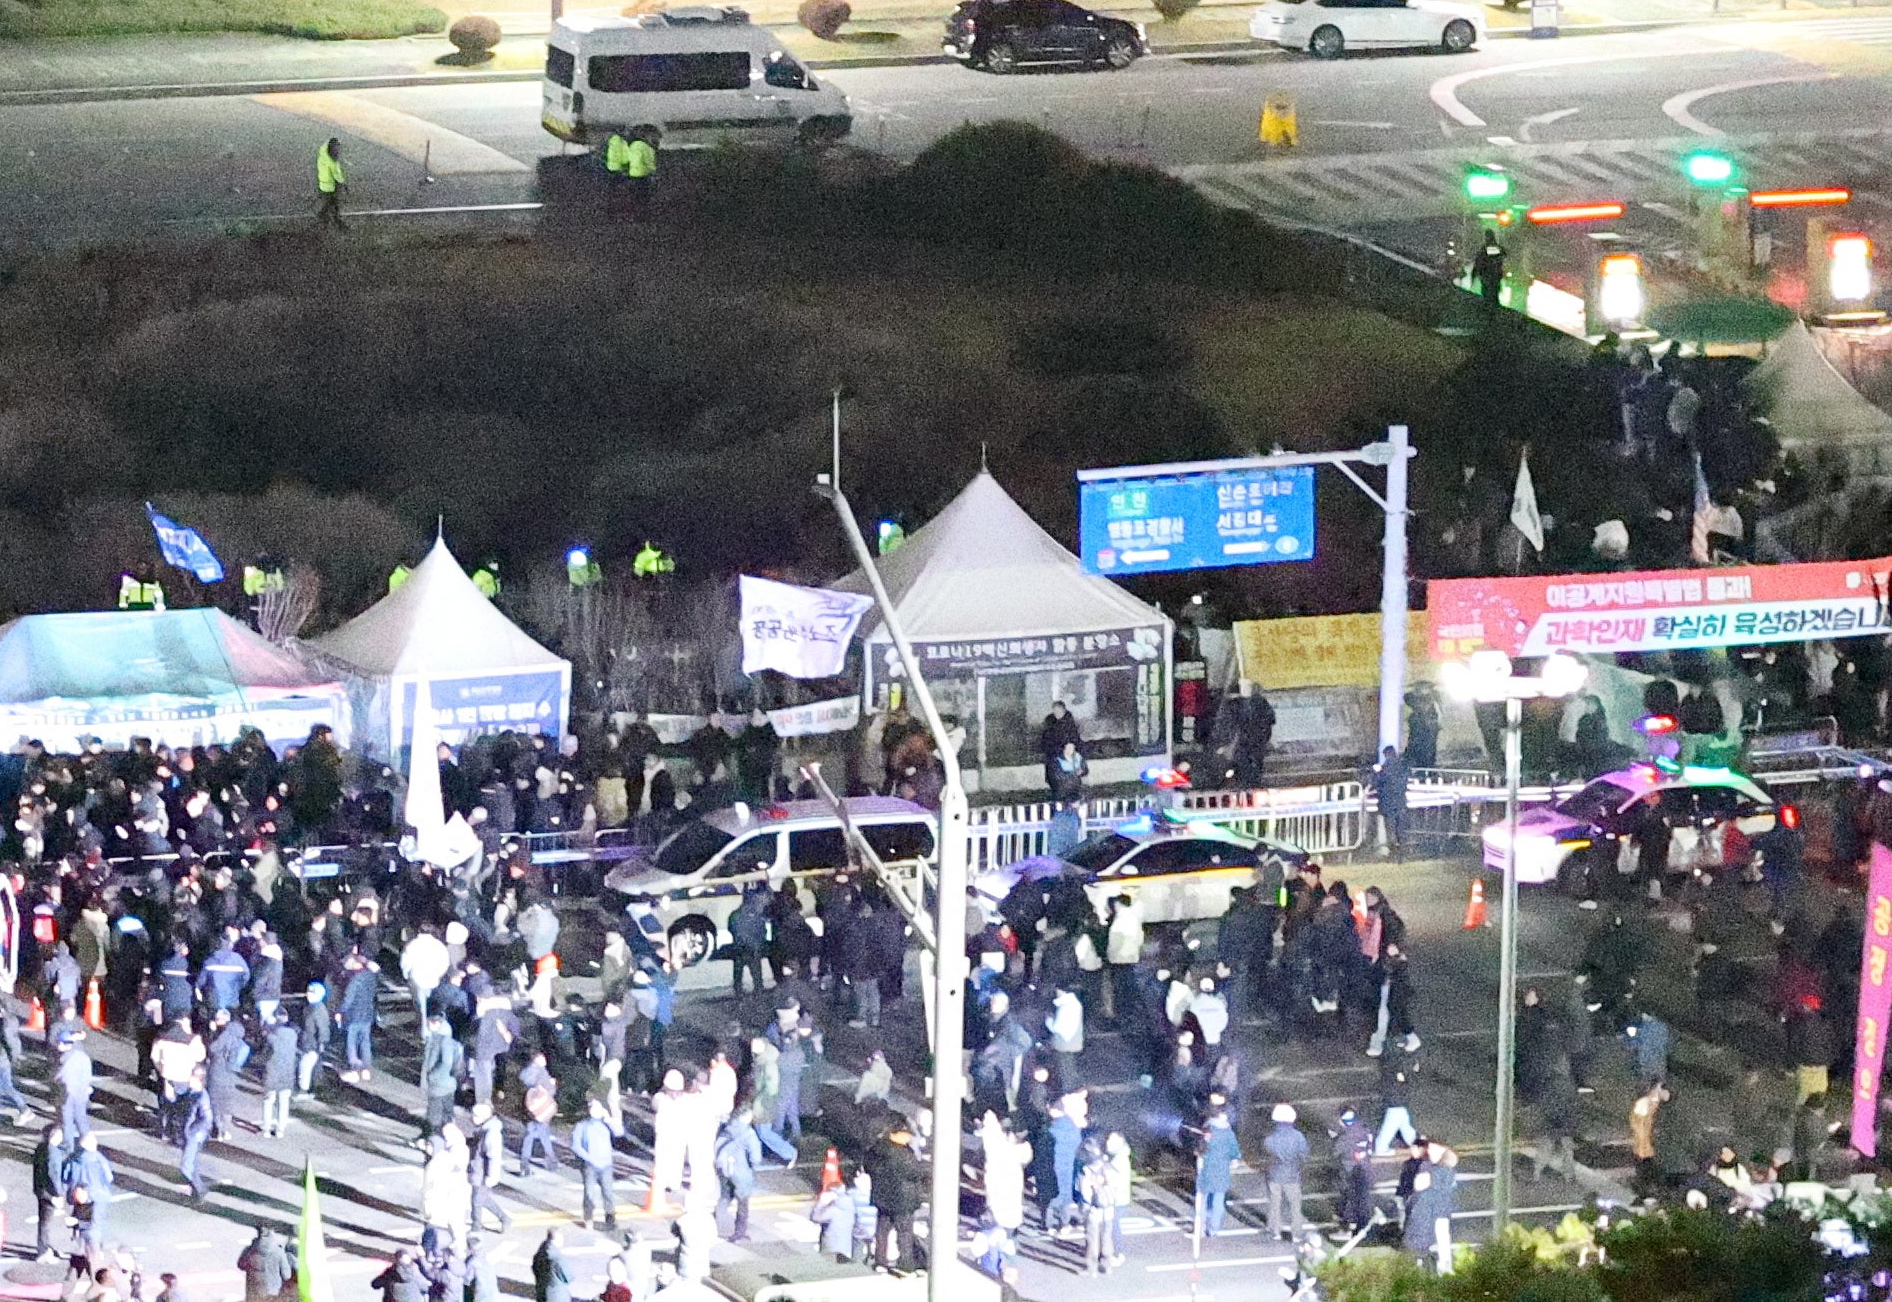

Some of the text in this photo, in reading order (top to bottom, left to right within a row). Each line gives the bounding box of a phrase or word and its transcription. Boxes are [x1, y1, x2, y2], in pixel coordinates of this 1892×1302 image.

[1545, 606, 1892, 646] 과학인재 확실히 육성하겠습니
